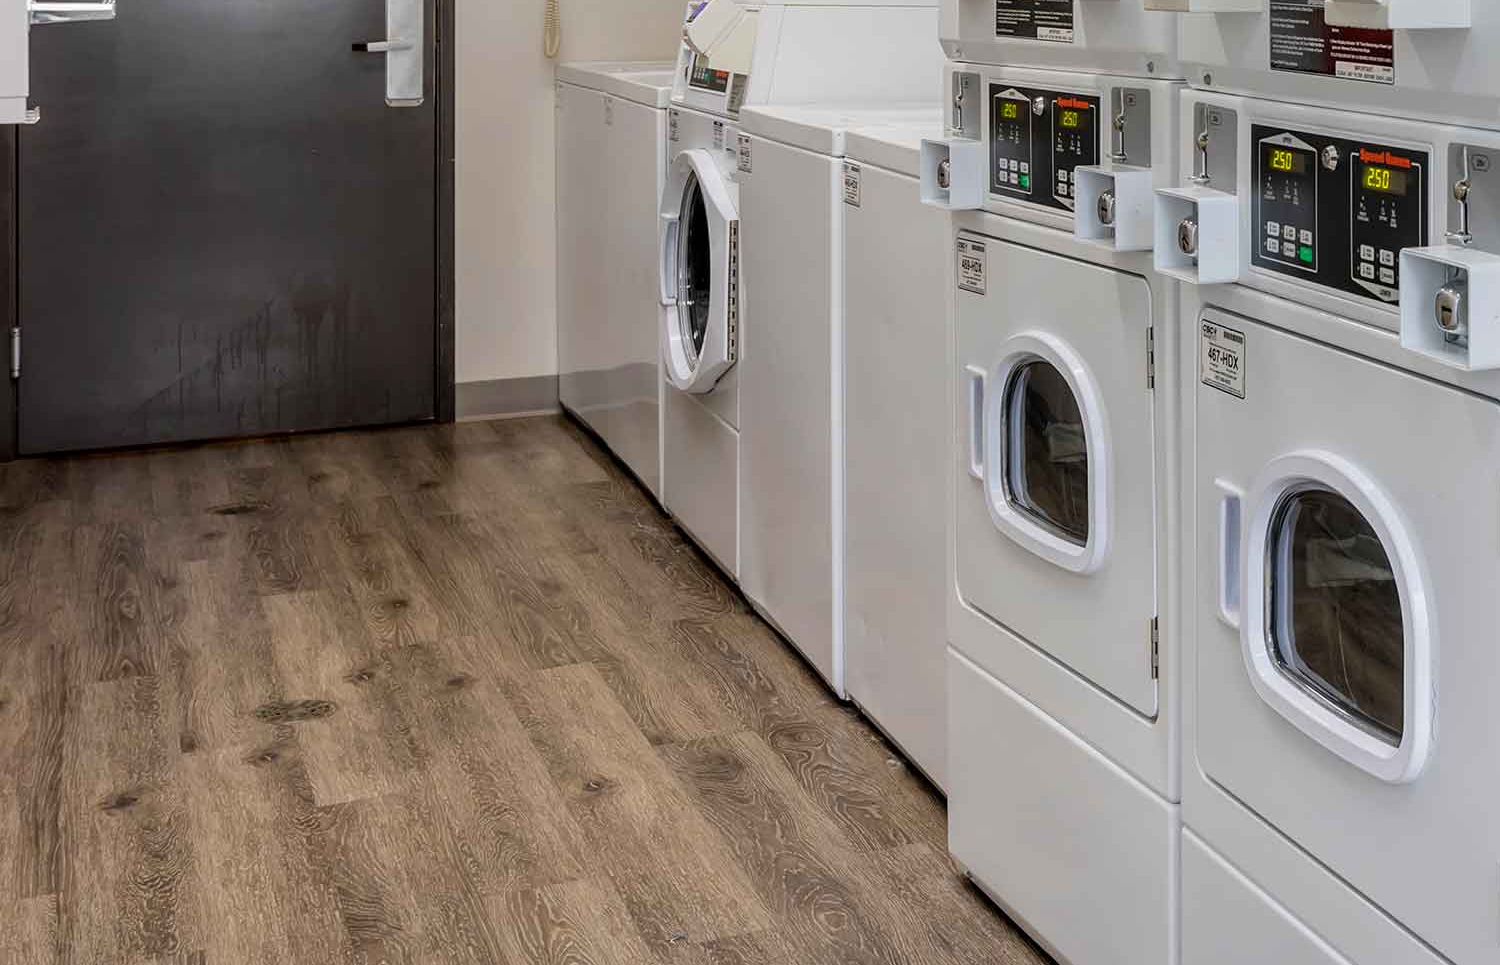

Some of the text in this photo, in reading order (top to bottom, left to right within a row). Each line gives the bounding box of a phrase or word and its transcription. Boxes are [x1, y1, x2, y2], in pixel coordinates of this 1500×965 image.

[1359, 147, 1412, 168] Speed Queen
[1207, 347, 1239, 371] 467-HDX
